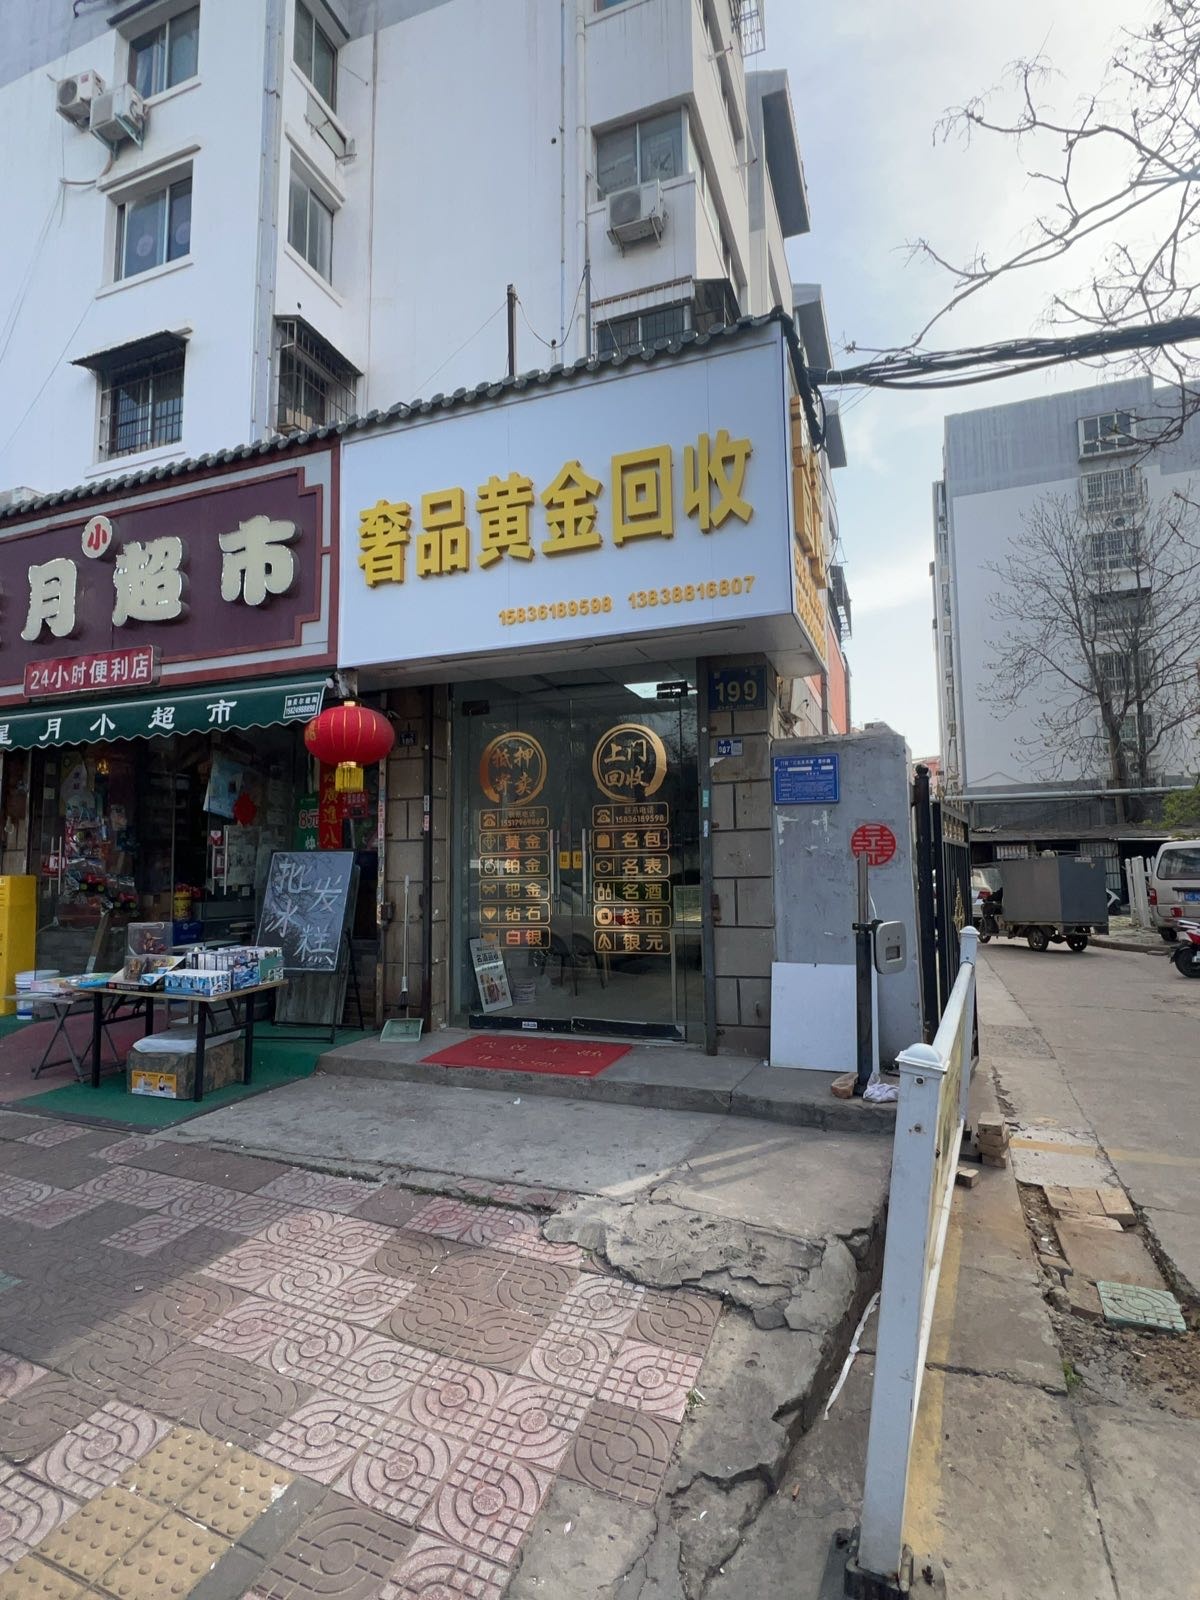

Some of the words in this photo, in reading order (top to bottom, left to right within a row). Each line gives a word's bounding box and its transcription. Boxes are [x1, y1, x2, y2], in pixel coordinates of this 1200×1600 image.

[356, 429, 754, 588] 奢品黄金回收
[498, 596, 612, 626] 15836189598
[628, 576, 755, 609] 13838816807
[30, 653, 148, 690] 24小时便利店
[715, 680, 757, 703] 199
[604, 739, 647, 763] 上门
[604, 766, 649, 788] 回收
[505, 834, 541, 850] 黄金
[622, 832, 661, 848] 名包
[504, 858, 541, 874] 铂金
[622, 858, 663, 875] 名表
[505, 882, 542, 898] 钯金
[622, 883, 663, 900] 名酒
[505, 905, 541, 921] 钻石
[623, 908, 663, 926] 钱币
[506, 930, 542, 946] 白银
[623, 933, 664, 951] 银元
